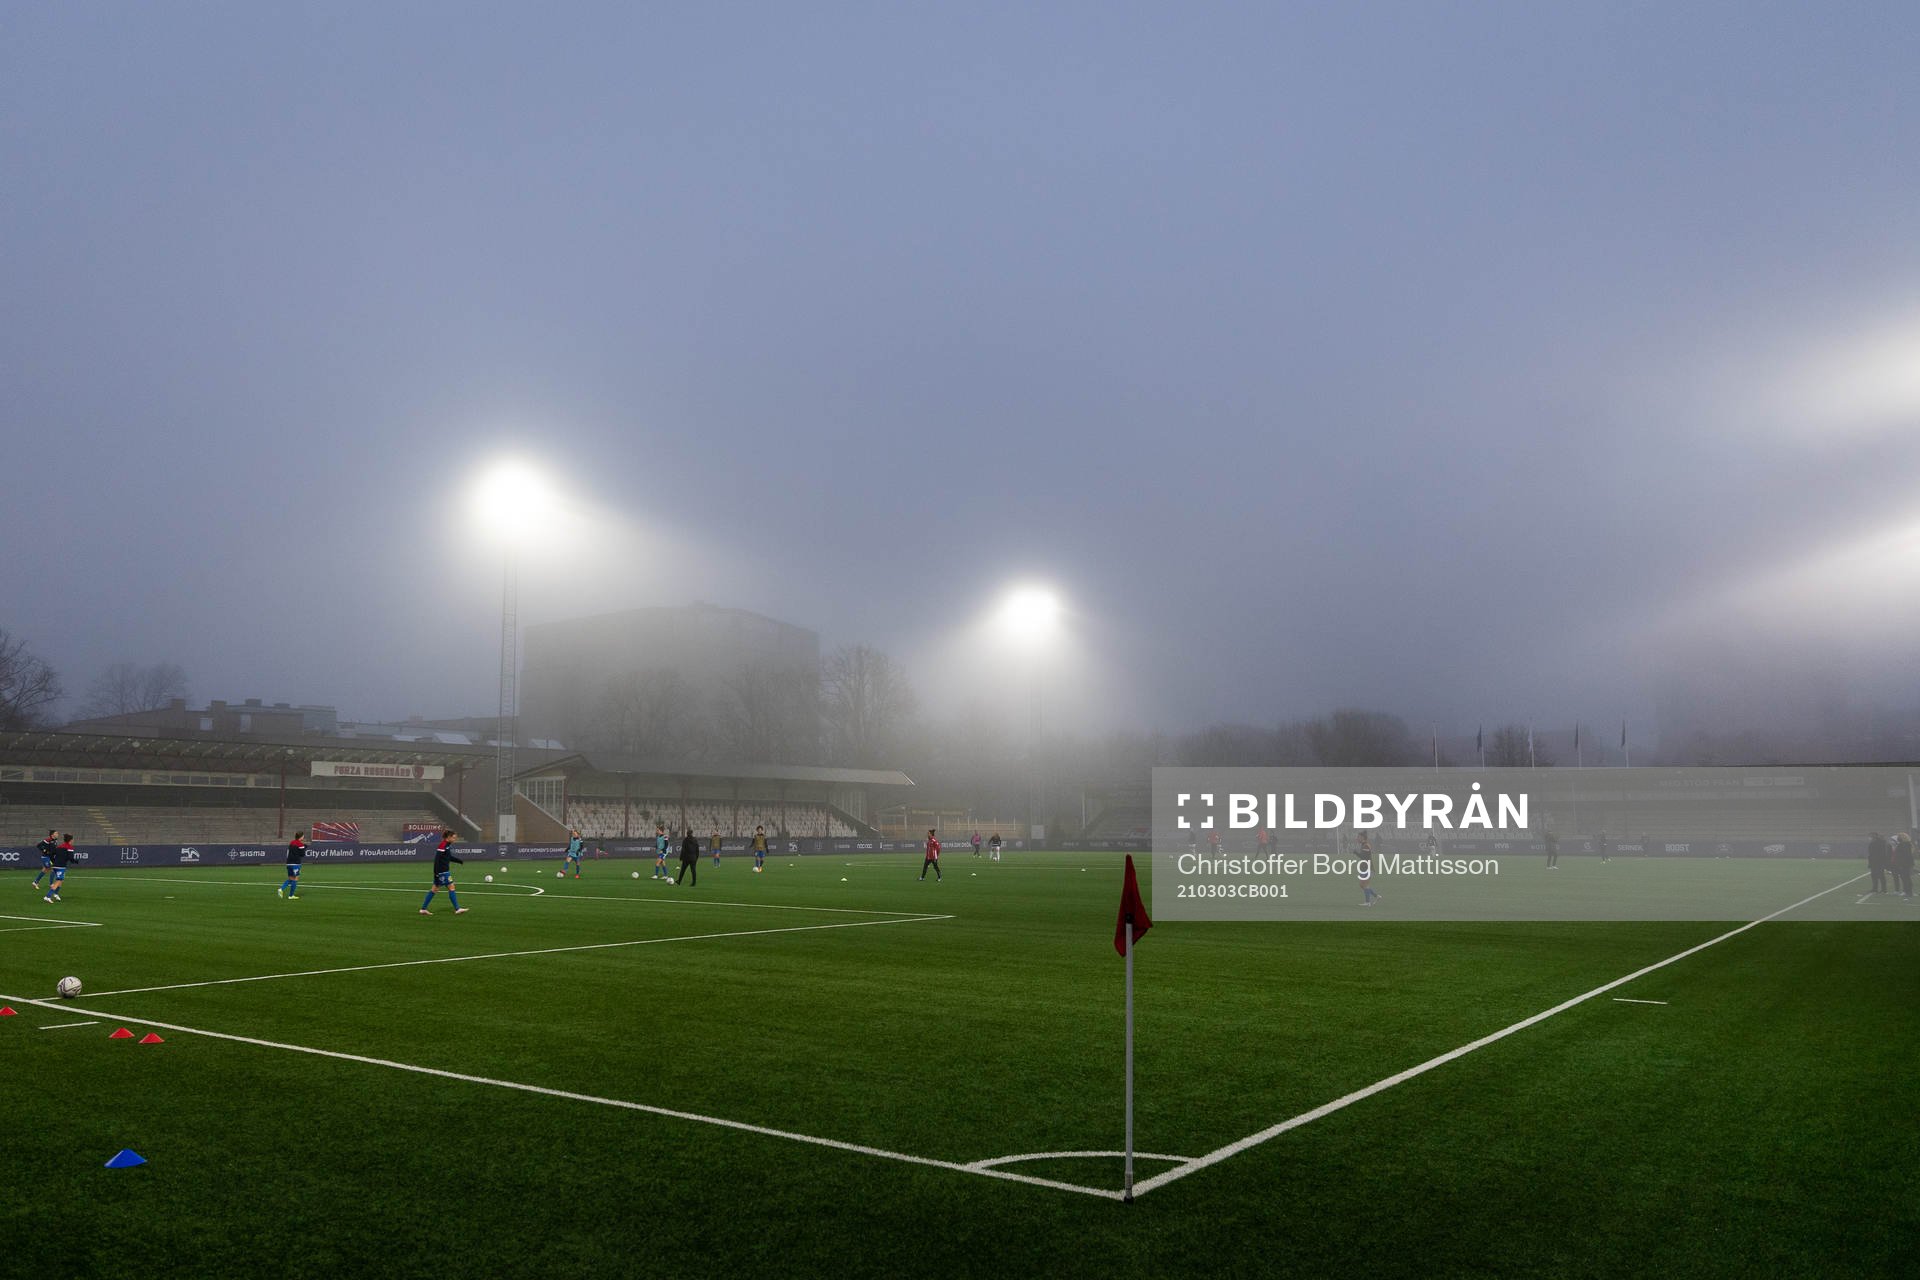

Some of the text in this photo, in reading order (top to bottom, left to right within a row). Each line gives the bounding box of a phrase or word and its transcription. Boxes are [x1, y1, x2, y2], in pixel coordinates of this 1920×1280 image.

[334, 764, 361, 775] FORZA
[305, 849, 354, 858] City of Malmö
[360, 849, 417, 857] #YouAreIncluded
